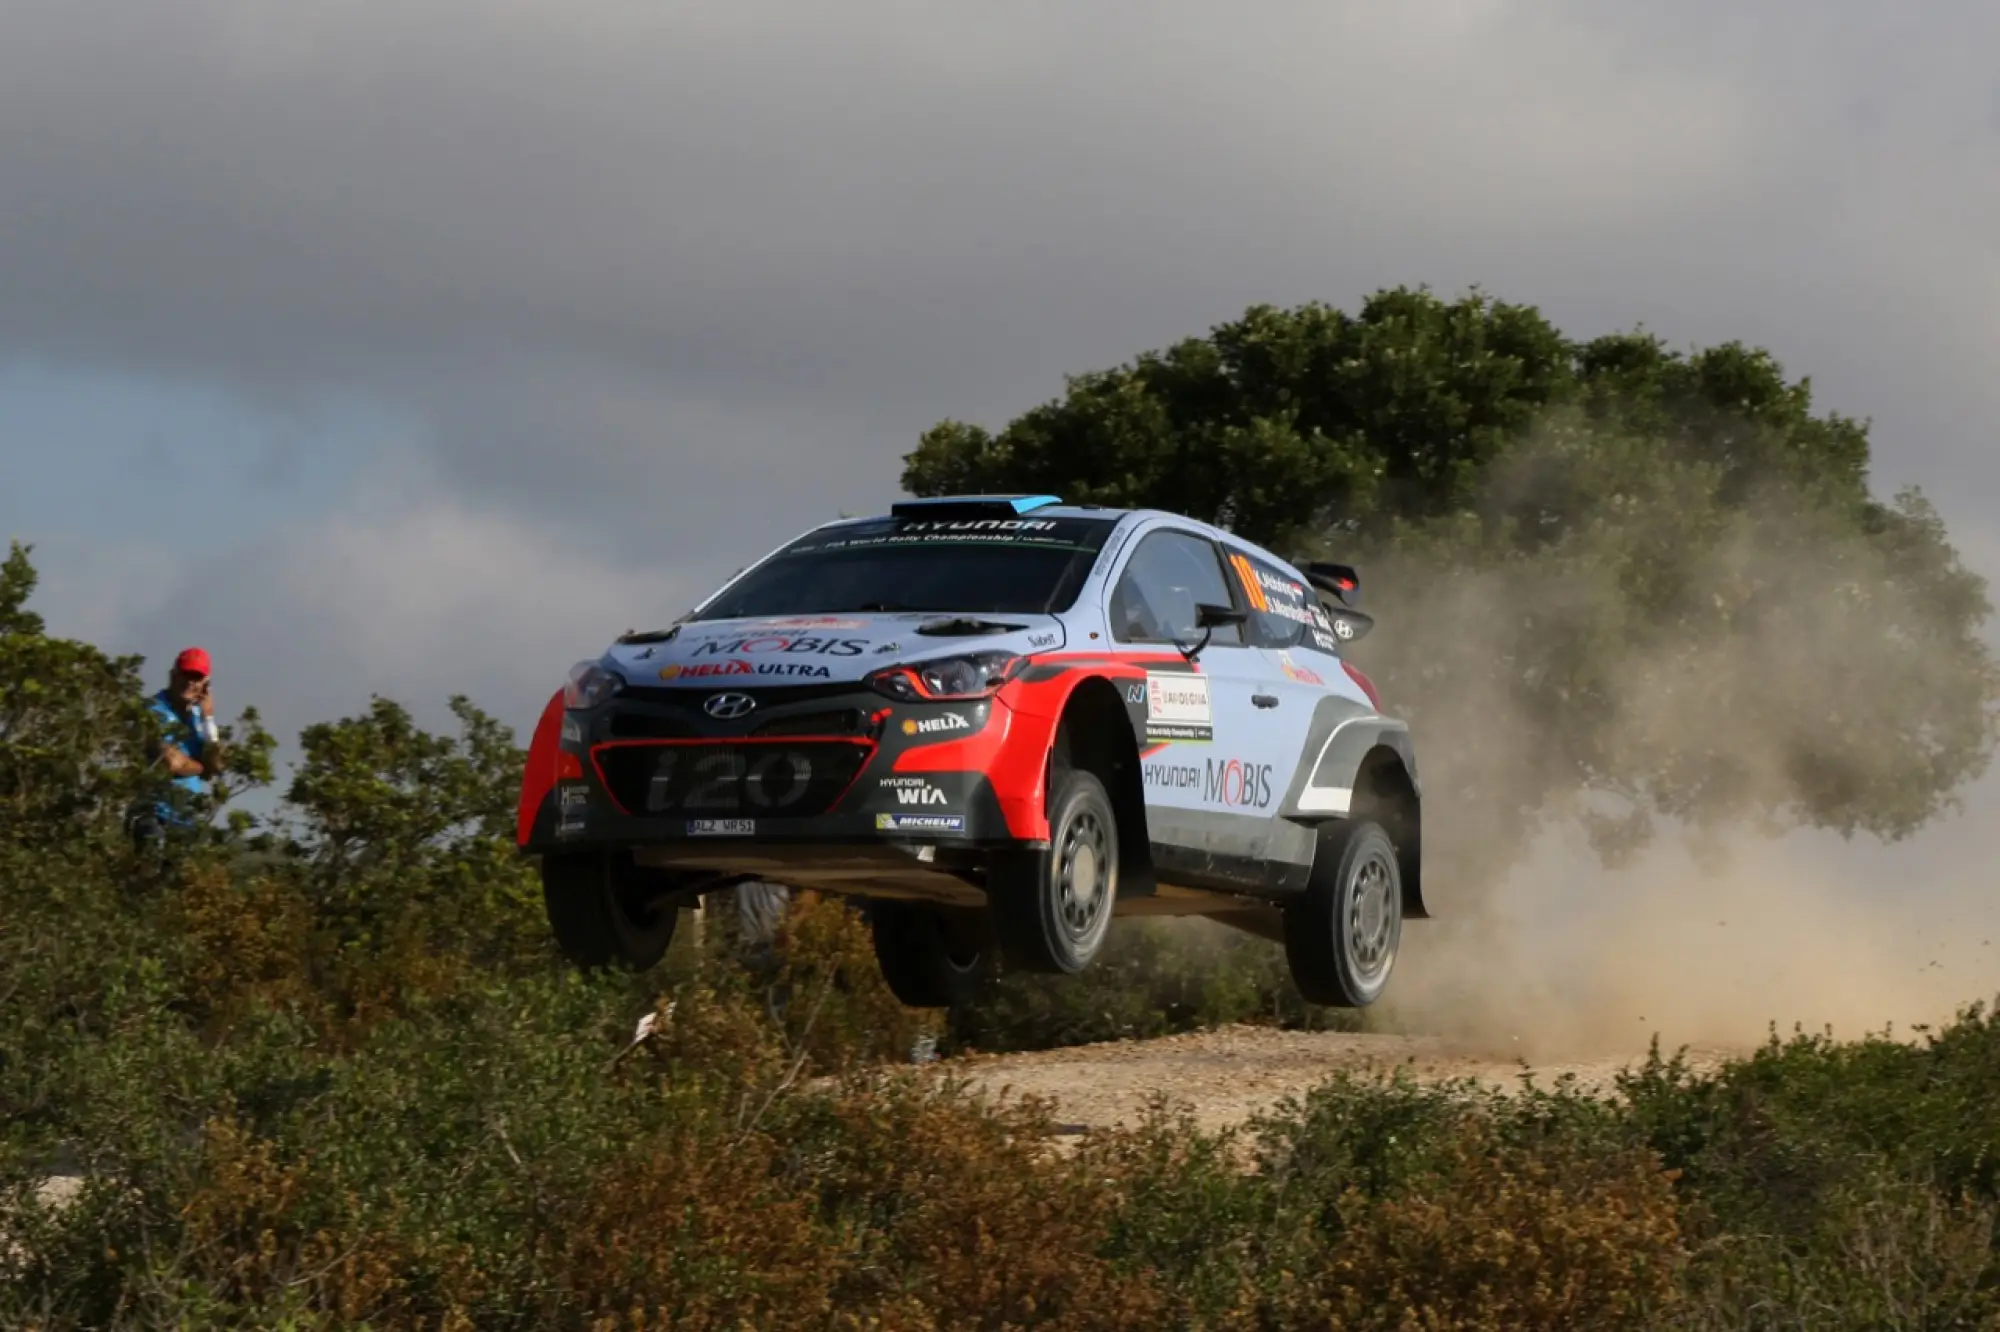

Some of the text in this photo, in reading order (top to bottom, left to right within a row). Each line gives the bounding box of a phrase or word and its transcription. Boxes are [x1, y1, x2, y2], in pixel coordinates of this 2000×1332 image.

[902, 519, 1057, 532] HYUNDAI
[691, 637, 871, 657] MOBIS
[679, 659, 831, 678] HELIX ULTRA
[918, 712, 970, 733] HELIX
[879, 777, 925, 788] HYUNDAI
[1143, 757, 1273, 809] HYUNDAI MOBIS
[899, 817, 961, 827] MICHELIN
